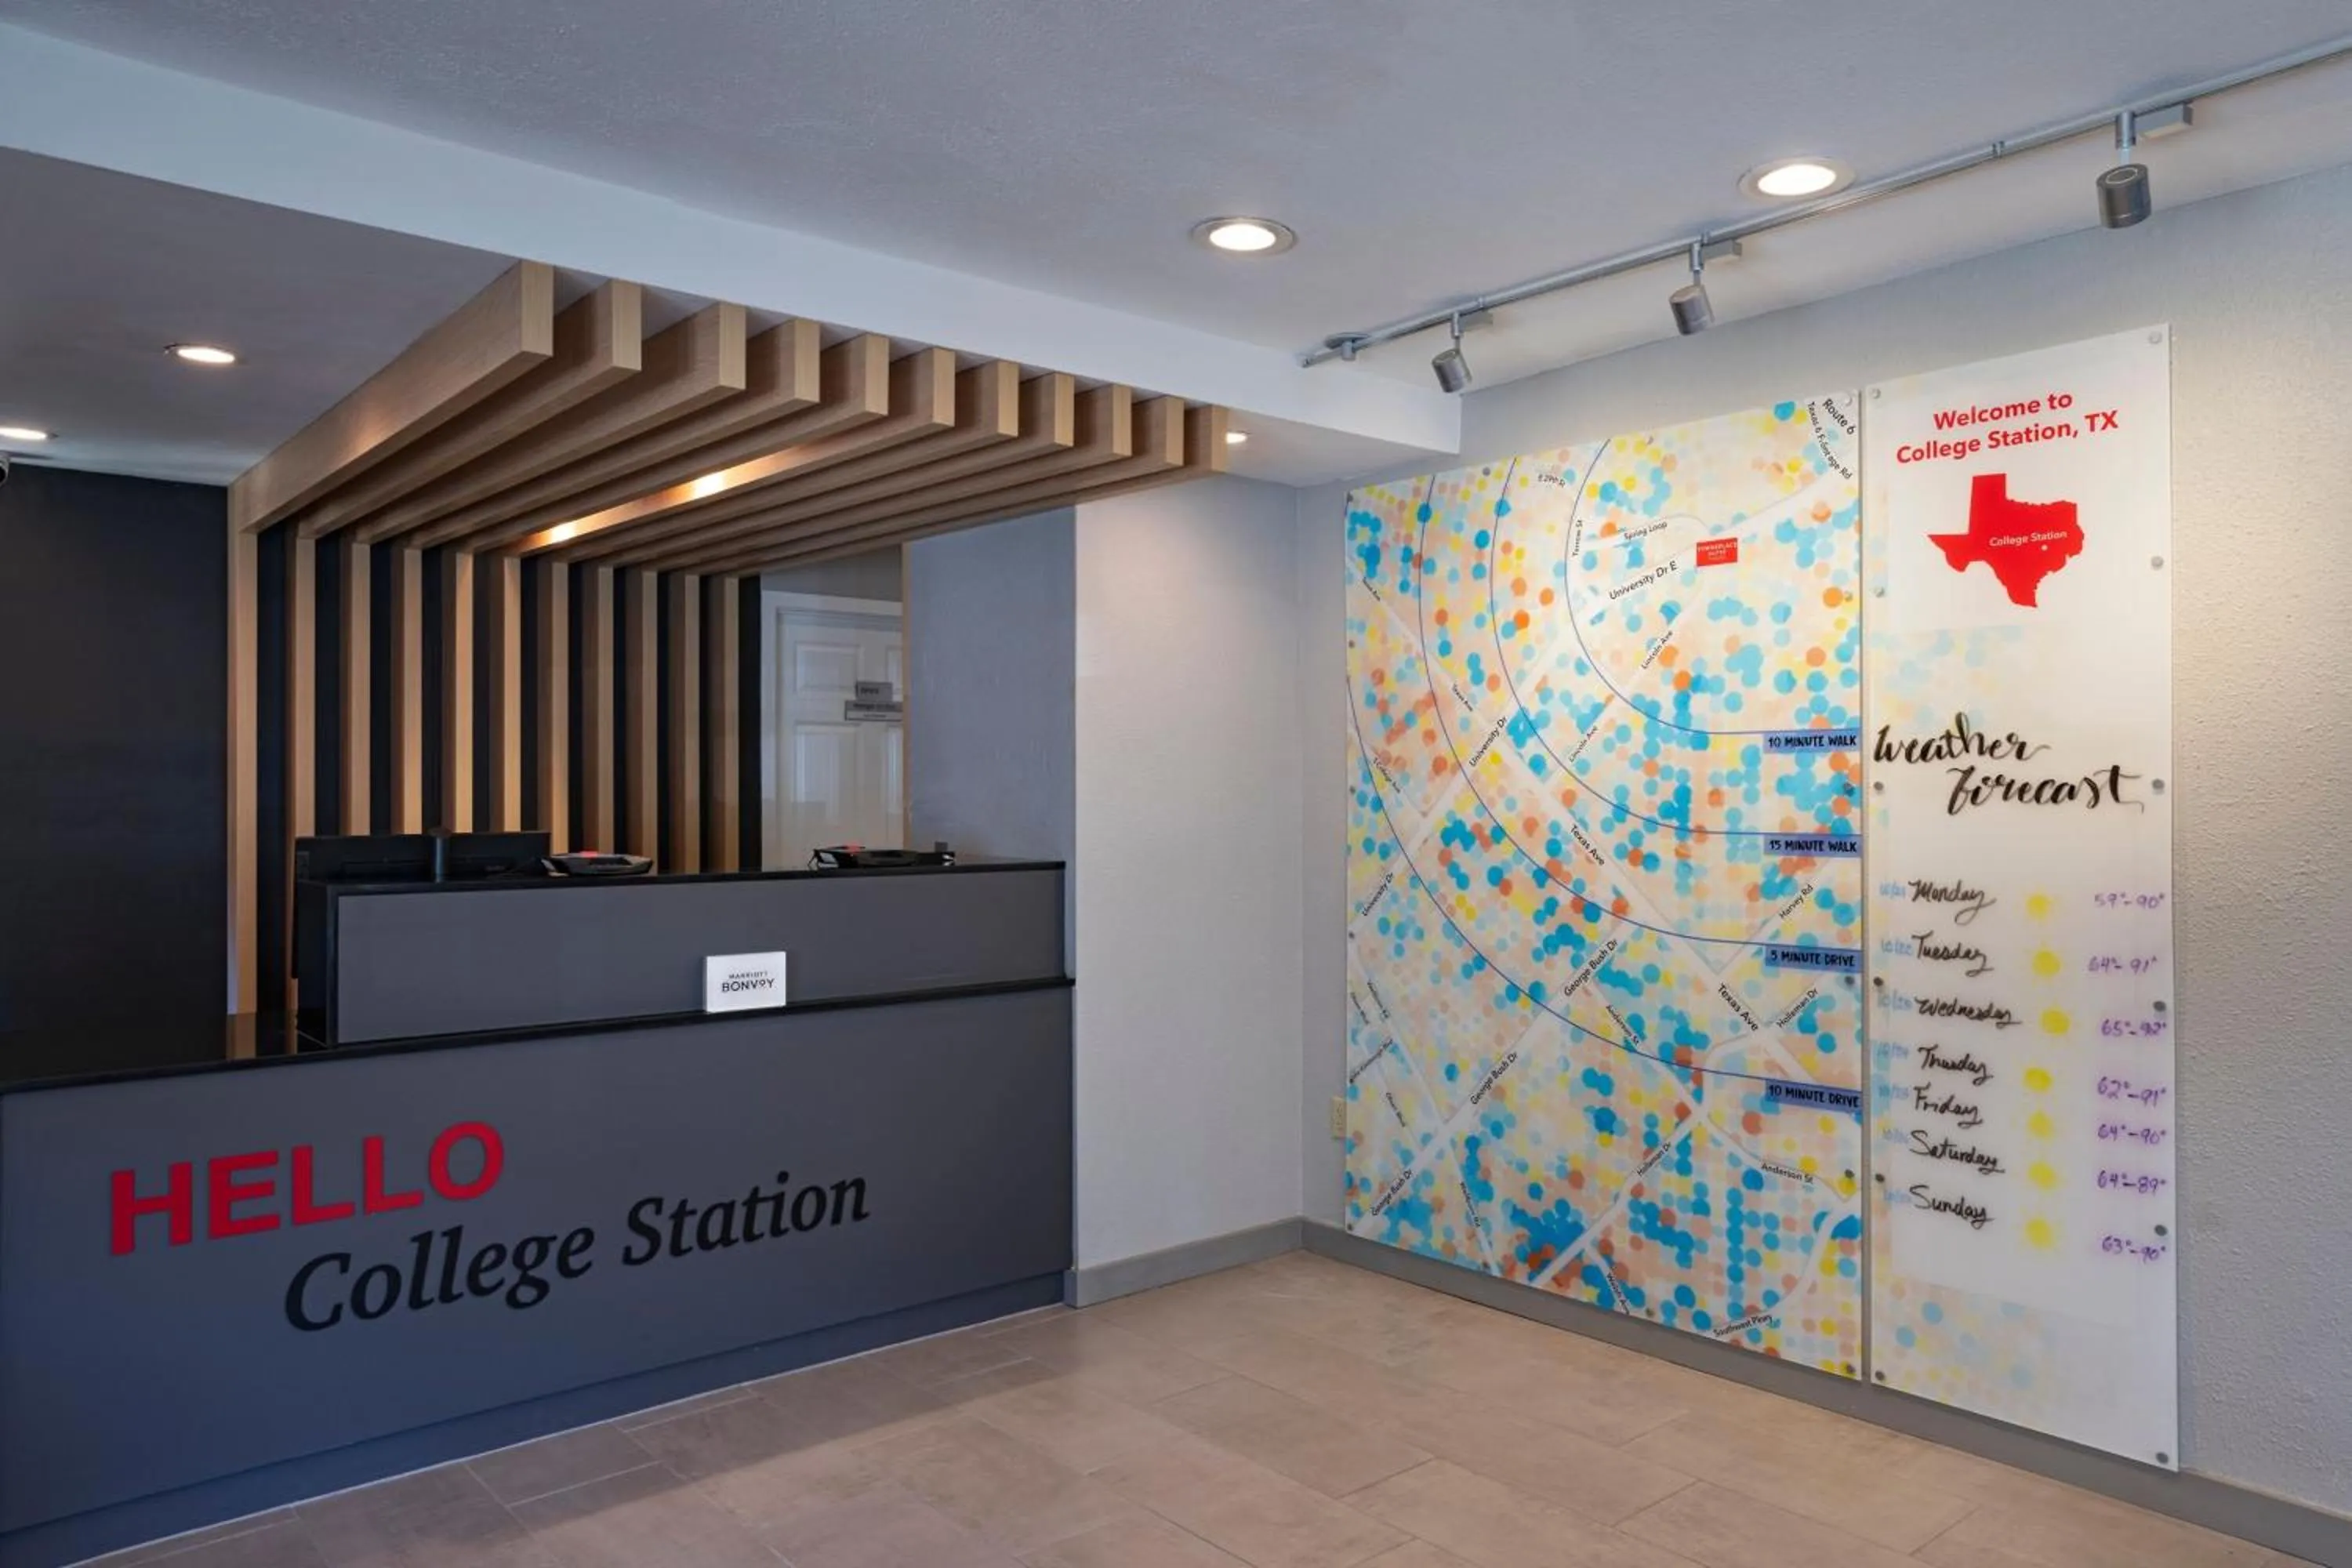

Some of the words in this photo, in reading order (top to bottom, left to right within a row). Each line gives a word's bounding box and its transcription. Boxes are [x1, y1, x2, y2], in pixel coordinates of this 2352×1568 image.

[1822, 398, 1848, 427] Route
[1846, 426, 1856, 435] 6
[1933, 399, 2040, 430] Welcome
[2048, 393, 2073, 411] to
[1896, 436, 1980, 463] College
[1987, 421, 2078, 449] Station,
[2084, 410, 2118, 433] TX
[1839, 467, 1853, 479] Rd
[1624, 528, 1647, 540] Spring
[1649, 521, 1668, 532] Loop
[1989, 535, 2028, 548] College
[2030, 529, 2067, 543] Station
[1609, 573, 1655, 600] University
[1656, 566, 1668, 579] Dr
[1669, 561, 1677, 571] E
[1641, 644, 1662, 670] Lincoln
[1661, 630, 1673, 644] Ave
[1469, 728, 1500, 767] University
[1497, 717, 1508, 728] Dr
[1769, 737, 1781, 748] 10
[1784, 735, 1824, 747] MINUTE
[1828, 735, 1857, 746] WALK
[1874, 712, 2052, 764] weather
[1946, 764, 2145, 815] forecast
[1570, 824, 1590, 849] Texas
[1589, 848, 1605, 866] Ave
[1770, 840, 1782, 851] 15
[1784, 840, 1824, 851] MINUTE
[1828, 841, 1857, 852] WALK
[1779, 893, 1805, 919] Harvey
[1801, 884, 1813, 895] Rd
[1907, 879, 1998, 925] Monday
[1564, 968, 1592, 996] George
[1588, 949, 1608, 970] Bush
[1606, 939, 1617, 951] Dr
[1770, 949, 1777, 961] 5
[1781, 950, 1823, 964] MINUTE
[1824, 953, 1856, 967] DRIVE
[1911, 930, 1994, 977] Tuesday
[721, 978, 775, 993] BONVOY
[728, 970, 768, 979] MARRIOTT
[1718, 982, 1741, 1012] Texas
[1740, 1008, 1759, 1032] Ave
[1777, 996, 1810, 1028] Holleman
[1807, 988, 1819, 999] Dr
[1914, 996, 2021, 1029] Wednesday
[1470, 1074, 1494, 1105] George
[1491, 1061, 1510, 1080] Bush
[1507, 1051, 1518, 1064] Dr
[1769, 1084, 1782, 1096] 10
[1785, 1087, 1826, 1103] MINUTE
[1828, 1092, 1860, 1108] DRIVE
[1913, 1082, 1984, 1128] Friday
[1909, 1130, 2005, 1175] Saturday
[111, 1120, 504, 1255] HELLO
[1403, 1169, 1412, 1180] Dr
[1909, 1185, 1994, 1229] Sunday
[285, 1222, 594, 1331] College
[622, 1171, 870, 1265] Station
